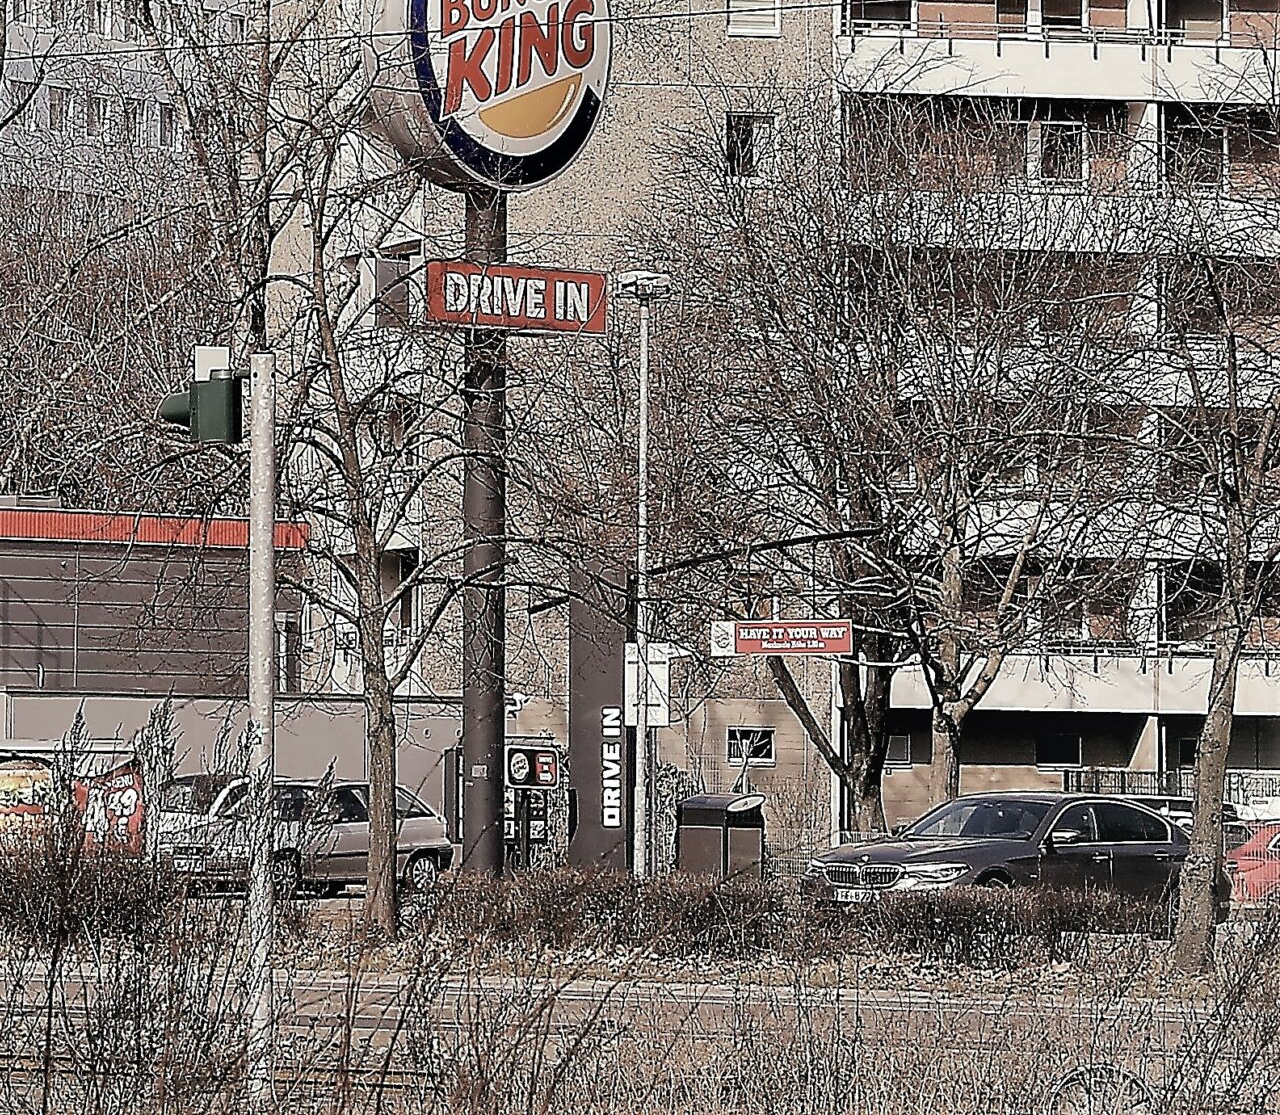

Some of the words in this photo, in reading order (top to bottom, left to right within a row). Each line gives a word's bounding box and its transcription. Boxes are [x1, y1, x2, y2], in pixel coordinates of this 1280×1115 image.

[445, 272, 547, 319] DRIVE
[555, 280, 590, 323] IN
[739, 627, 771, 640] HAVE
[771, 627, 785, 639] IT
[787, 627, 818, 639] YOUR
[820, 626, 846, 639] WAY
[602, 707, 621, 737] IN
[602, 743, 621, 827] DRIVE
